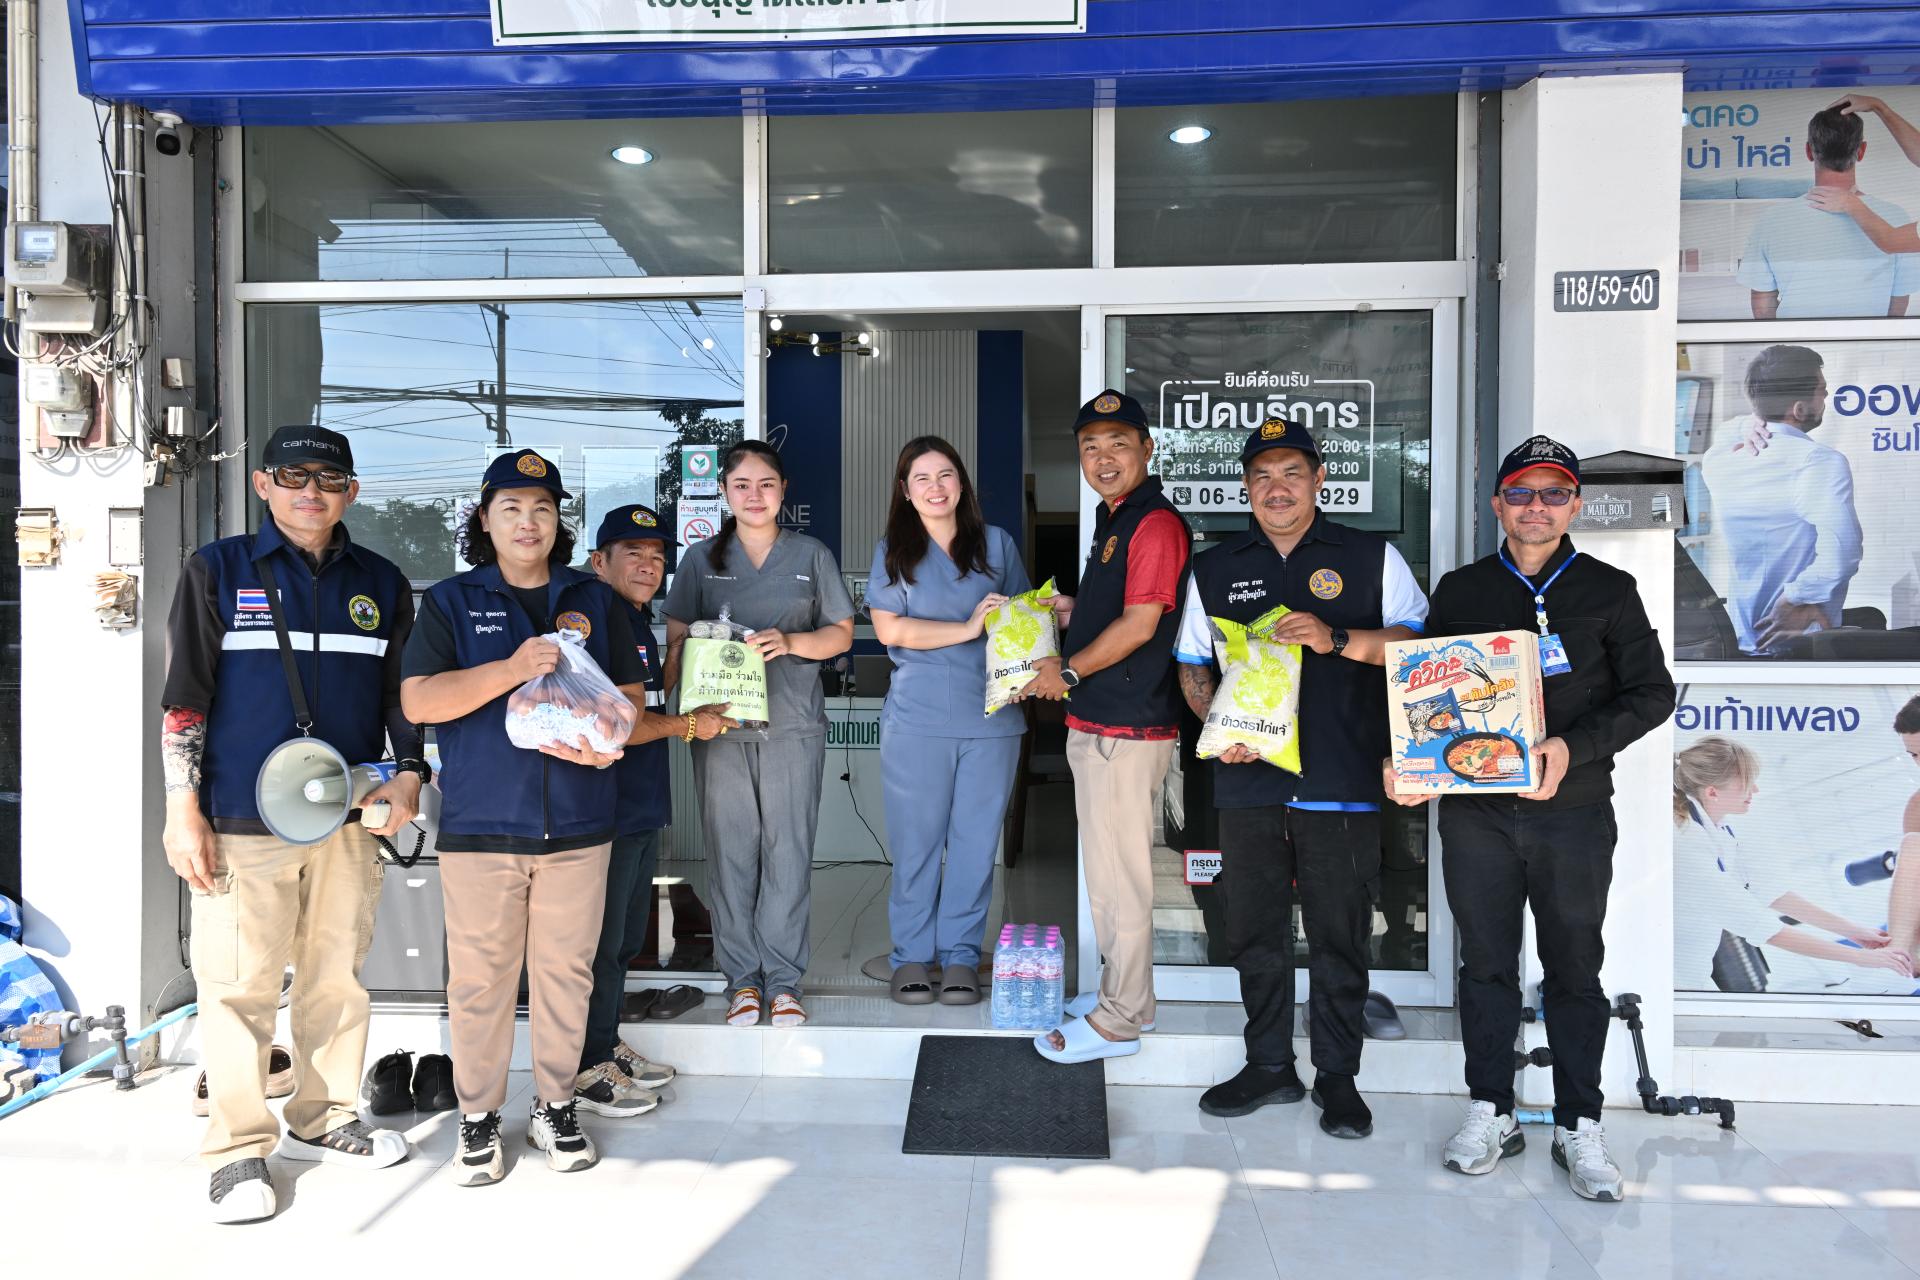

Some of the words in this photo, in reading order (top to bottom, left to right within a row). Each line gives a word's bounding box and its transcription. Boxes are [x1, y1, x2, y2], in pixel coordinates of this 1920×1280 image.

[1687, 137, 1721, 169] บ่า
[1732, 135, 1791, 168] ไหล่
[1562, 275, 1654, 306] 118/59-60
[1225, 370, 1310, 388] ยินดีต้อนรับ
[1174, 392, 1360, 429] เปิดบริการ
[1321, 440, 1360, 453] 20:00
[1320, 487, 1359, 505] 929
[1587, 504, 1607, 516] MAIL
[1609, 503, 1625, 516] BOX
[735, 670, 762, 683] ร่วมใจ
[1221, 715, 1288, 737] ข้าวตราไก่แจ้
